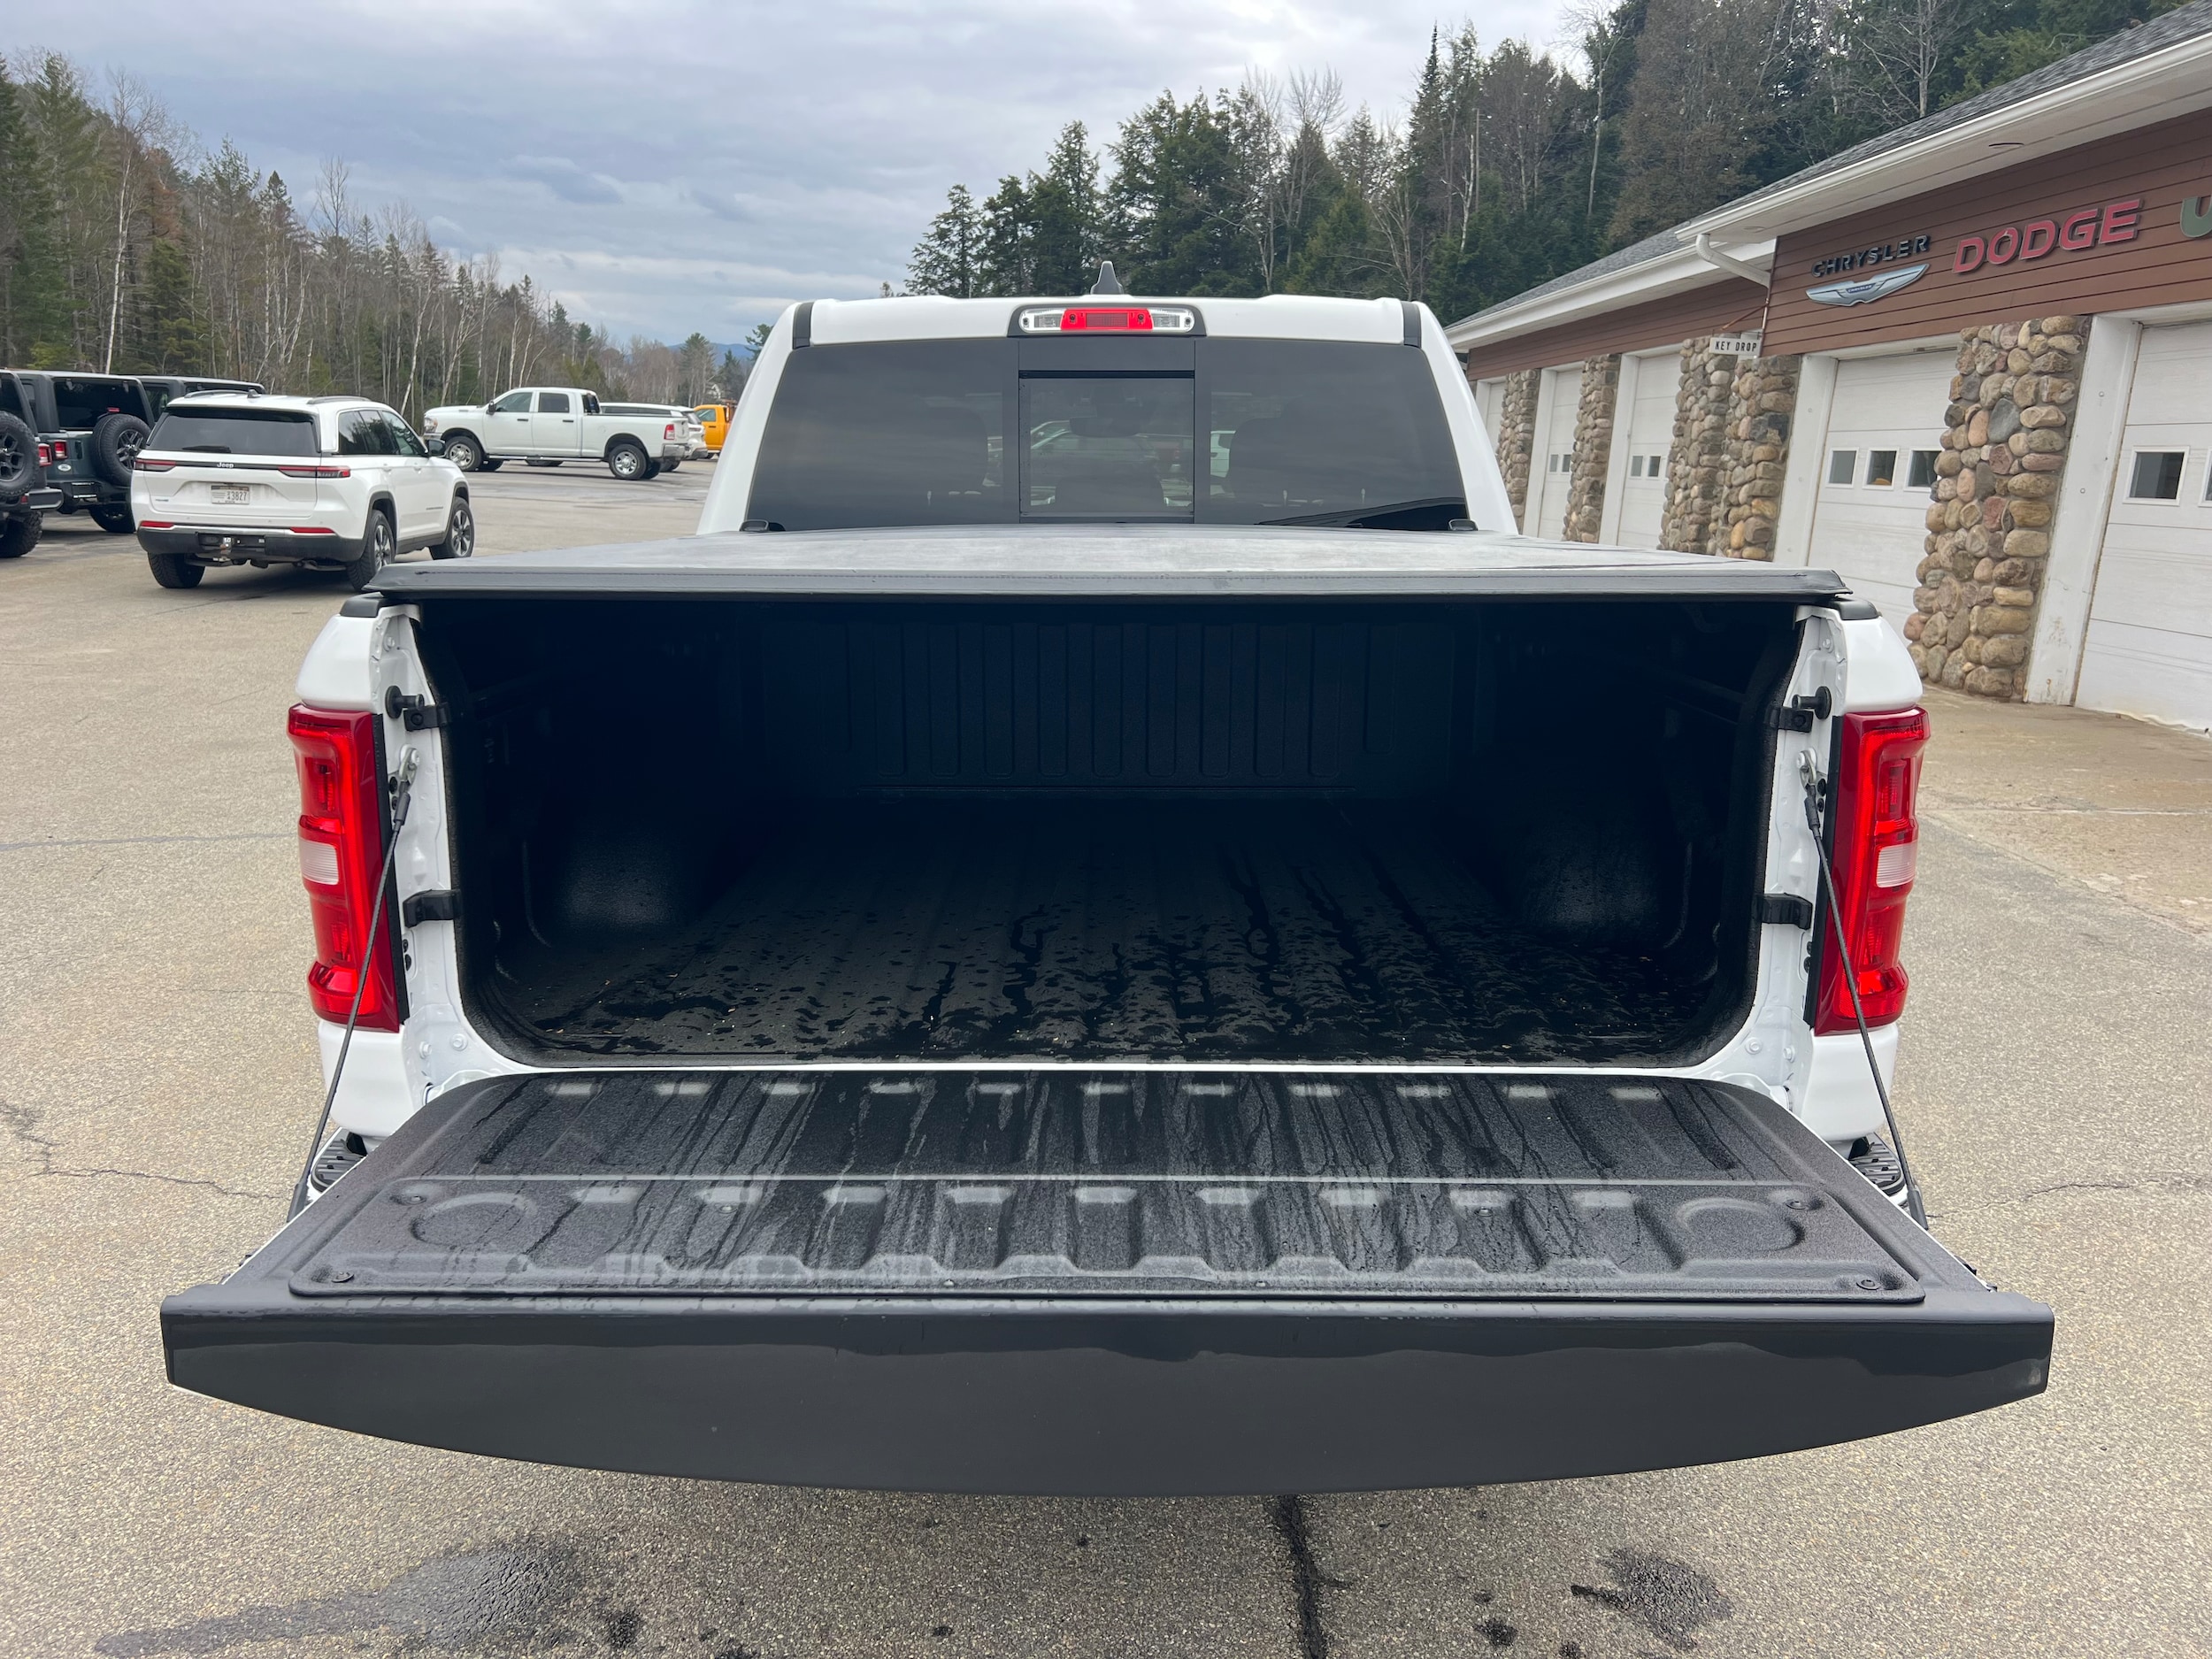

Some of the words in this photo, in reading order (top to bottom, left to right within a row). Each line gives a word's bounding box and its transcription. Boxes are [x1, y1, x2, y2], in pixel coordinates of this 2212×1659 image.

[1811, 234, 1931, 278] CHRYSLER
[1951, 198, 2143, 274] DODGE
[1715, 341, 1731, 350] KEY
[1735, 342, 1757, 352] DROP
